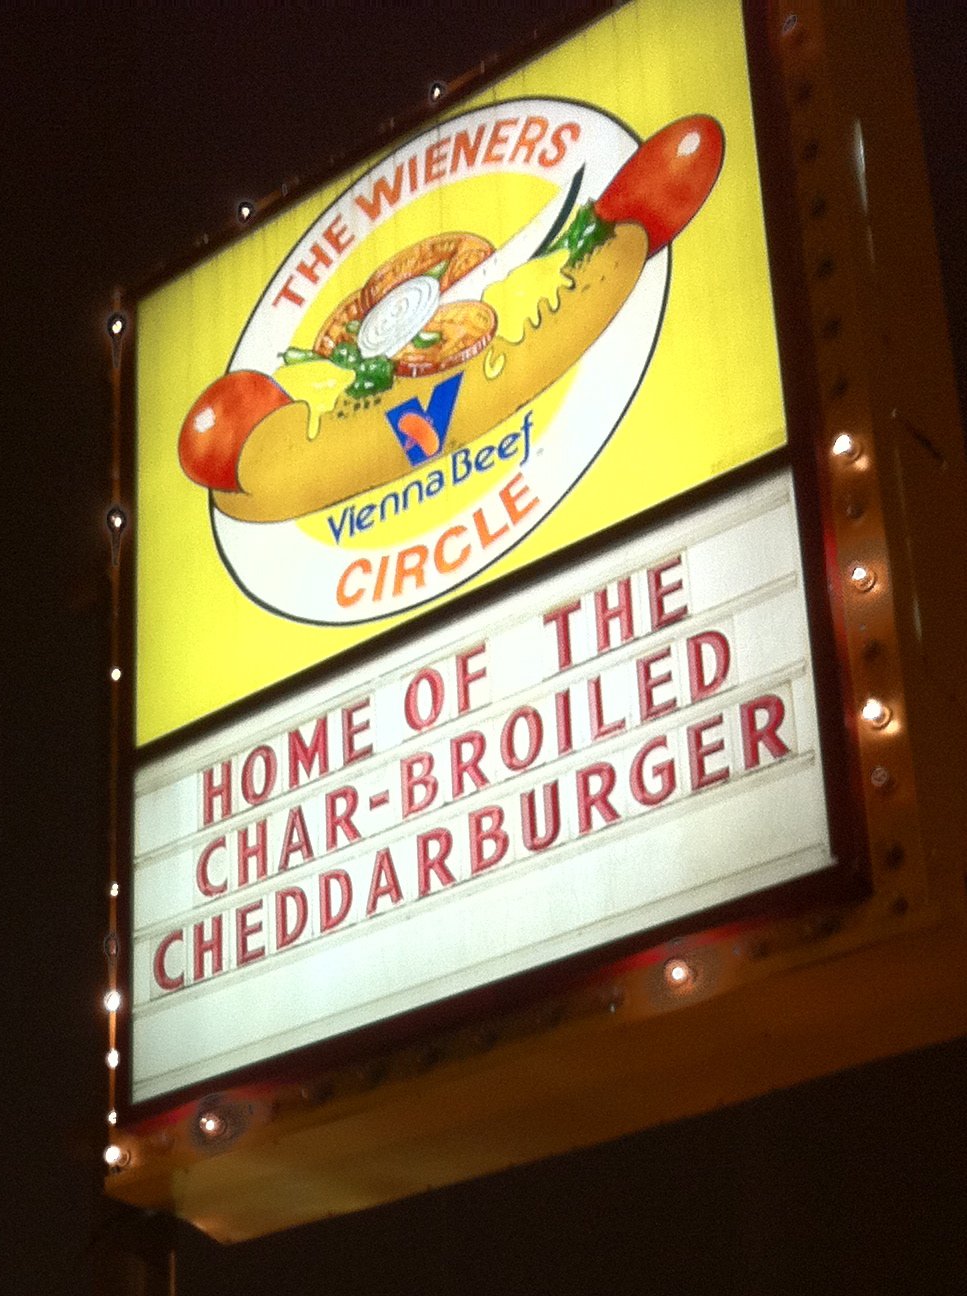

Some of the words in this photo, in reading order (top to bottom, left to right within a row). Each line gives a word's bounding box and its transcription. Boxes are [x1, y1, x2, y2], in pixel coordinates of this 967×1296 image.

[272, 213, 355, 308] THE
[355, 115, 581, 222] WIENERS
[327, 469, 445, 545] Vienna
[452, 409, 534, 487] Beef
[335, 472, 540, 608] CIRCLE
[195, 629, 732, 898] CHAR-BROILED
[201, 696, 374, 828] HOME
[403, 643, 488, 733] OF
[543, 554, 688, 672] THE
[152, 692, 792, 993] CHEDDARBURGER
